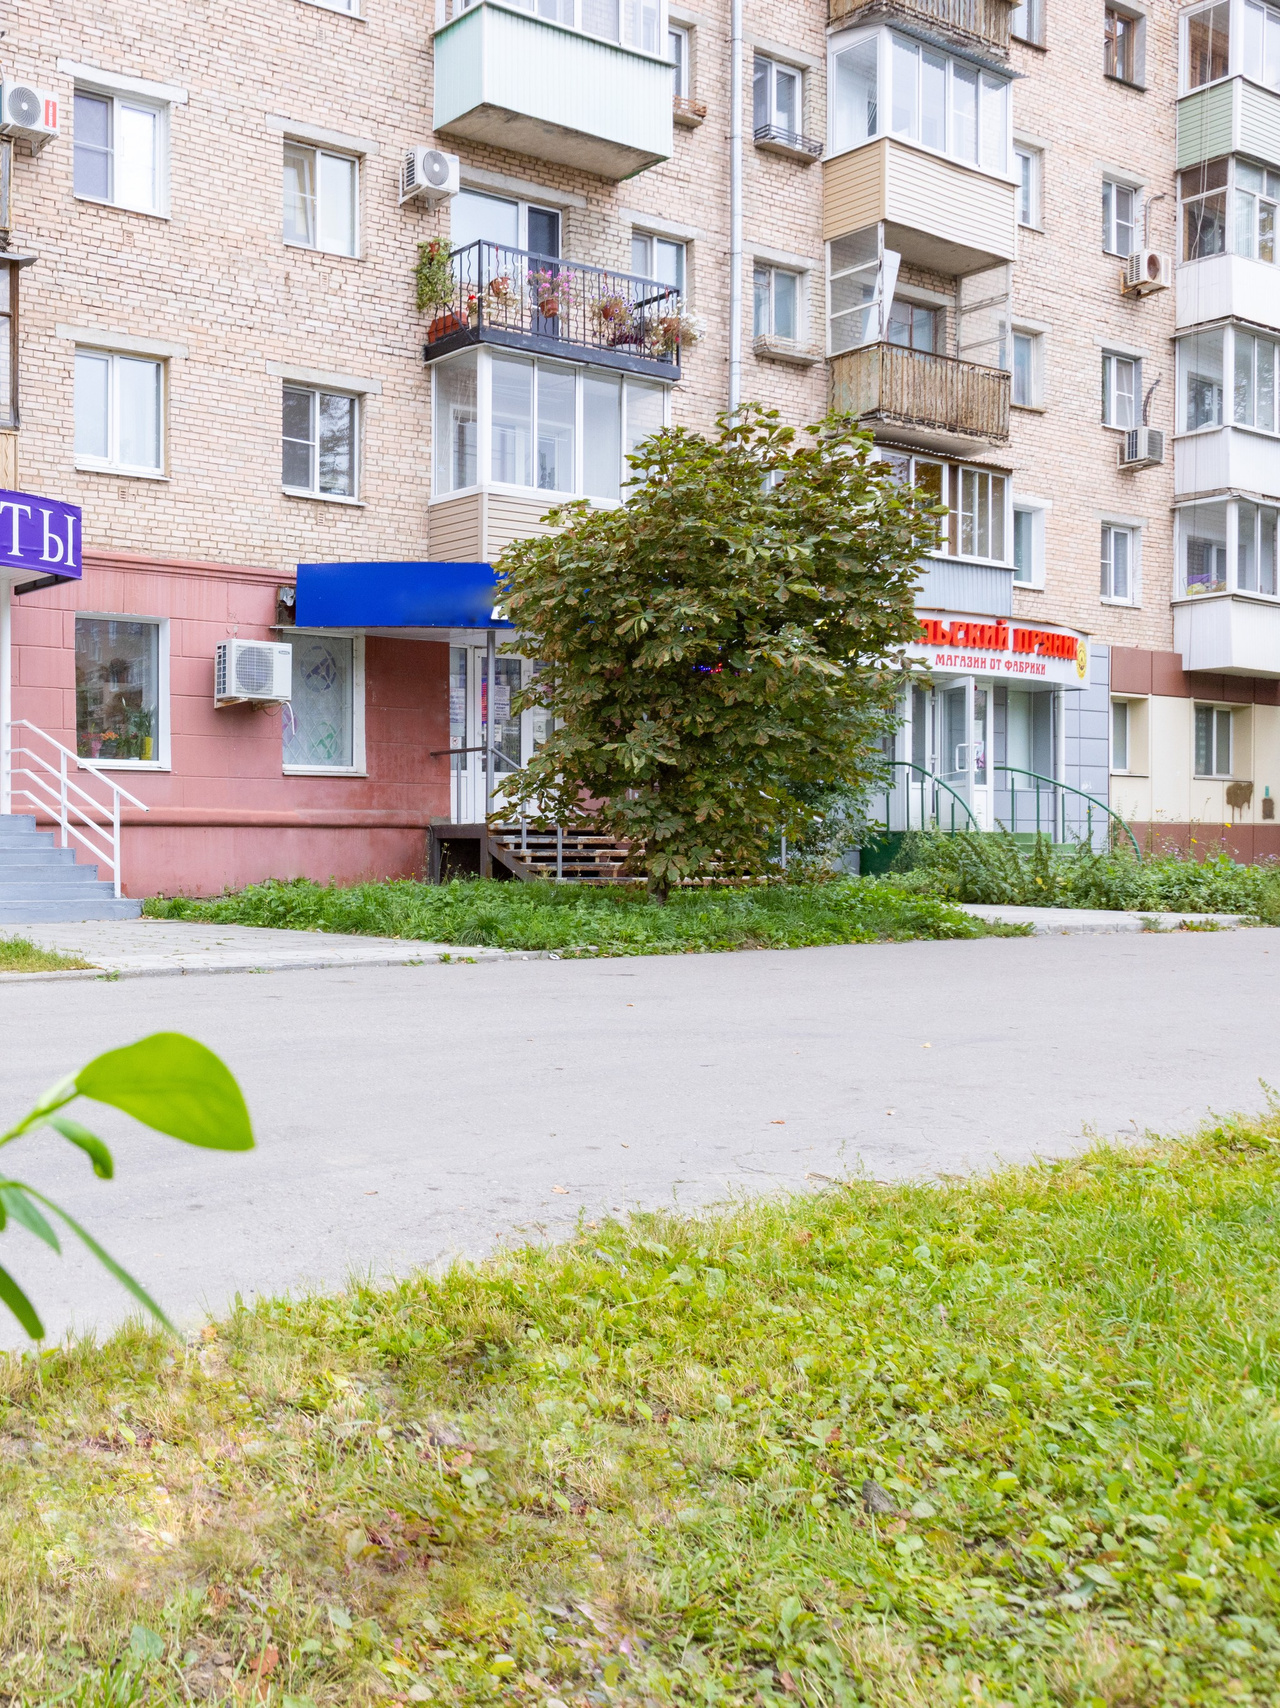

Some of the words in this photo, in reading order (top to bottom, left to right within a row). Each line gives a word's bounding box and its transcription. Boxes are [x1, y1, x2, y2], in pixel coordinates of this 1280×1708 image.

[900, 618, 1010, 651] ЛЬСКИЙ
[1012, 627, 1079, 661] ПРЯНИК
[935, 653, 987, 670] МАГАЗИН
[989, 658, 1002, 671] ОТ
[1004, 660, 1046, 675] ФАБРИКИ
